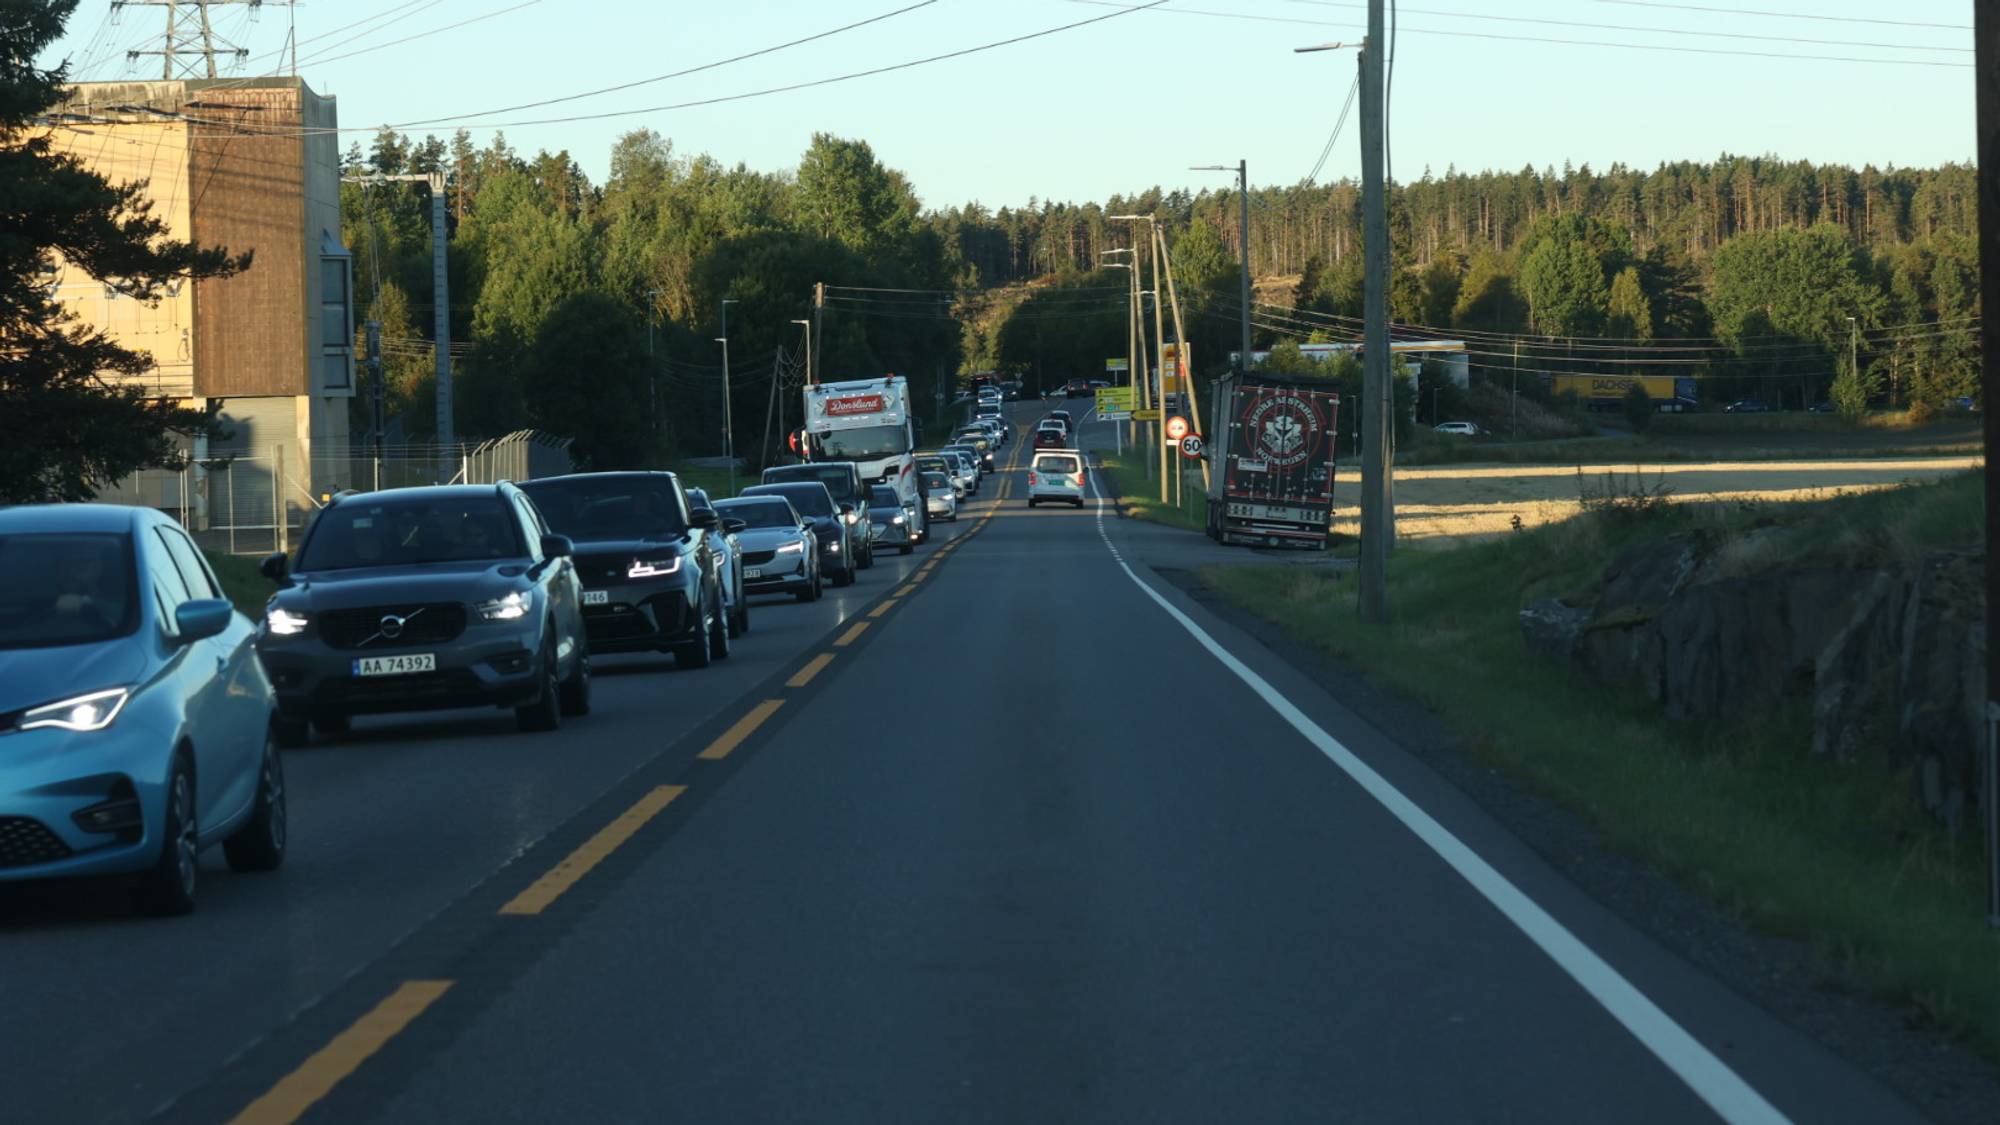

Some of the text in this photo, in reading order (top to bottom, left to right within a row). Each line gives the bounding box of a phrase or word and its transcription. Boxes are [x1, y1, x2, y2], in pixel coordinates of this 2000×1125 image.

[831, 398, 879, 411] Donslund
[1183, 439, 1201, 452] 60
[363, 656, 432, 673] AA 74392
